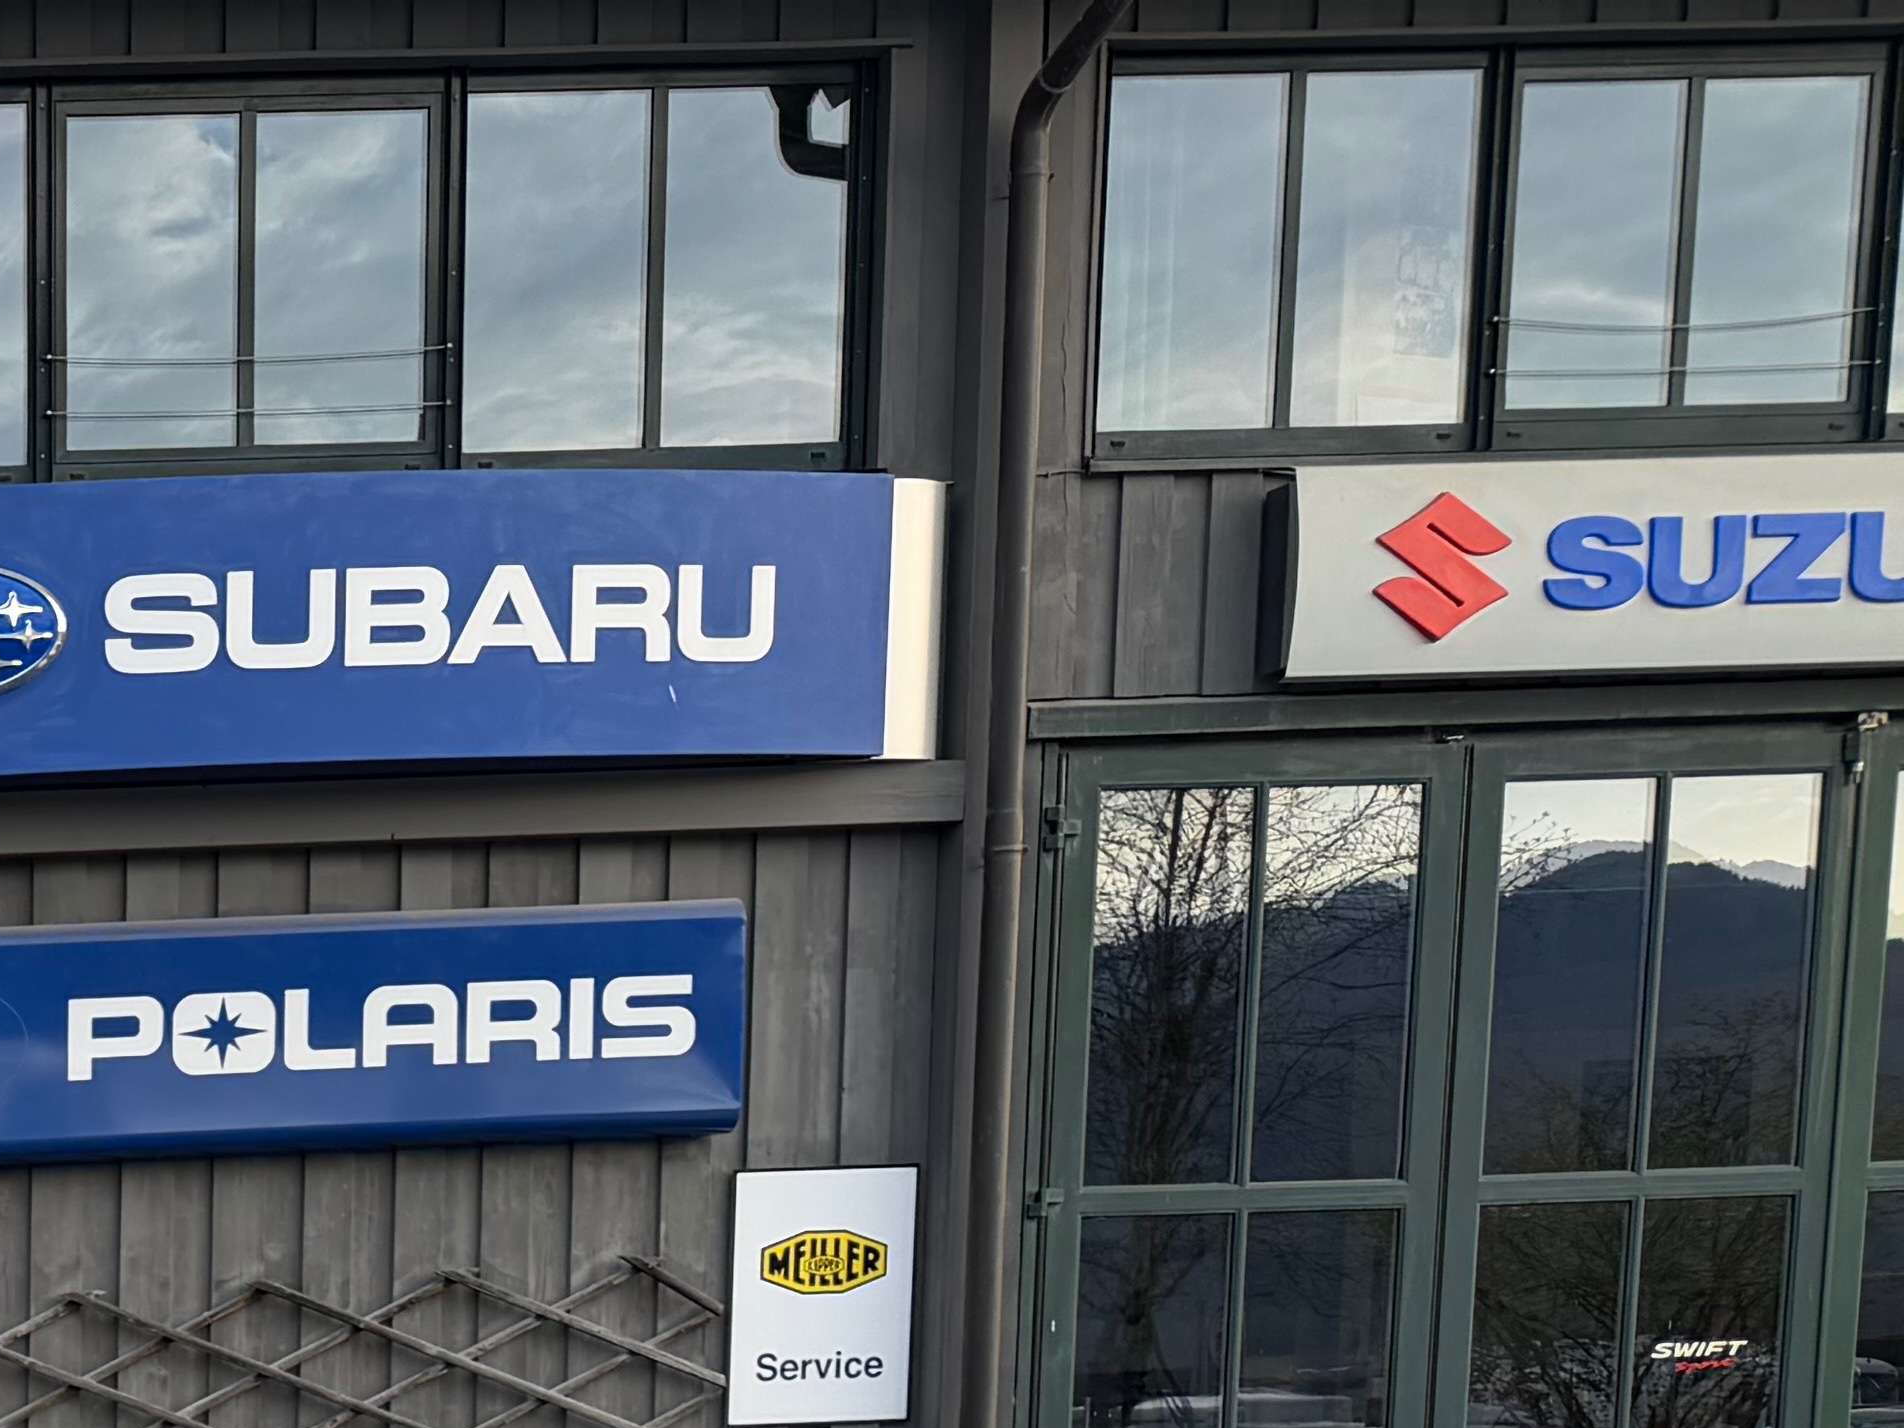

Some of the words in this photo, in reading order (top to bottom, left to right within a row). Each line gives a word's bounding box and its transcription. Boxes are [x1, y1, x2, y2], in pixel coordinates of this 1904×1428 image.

[1542, 511, 1904, 611] SUZU
[104, 563, 778, 675] SUBARU
[65, 972, 696, 1082] POLARIS
[768, 1237, 881, 1287] MEILLER
[755, 1351, 884, 1381] Service
[1650, 1340, 1749, 1359] SWIFT
